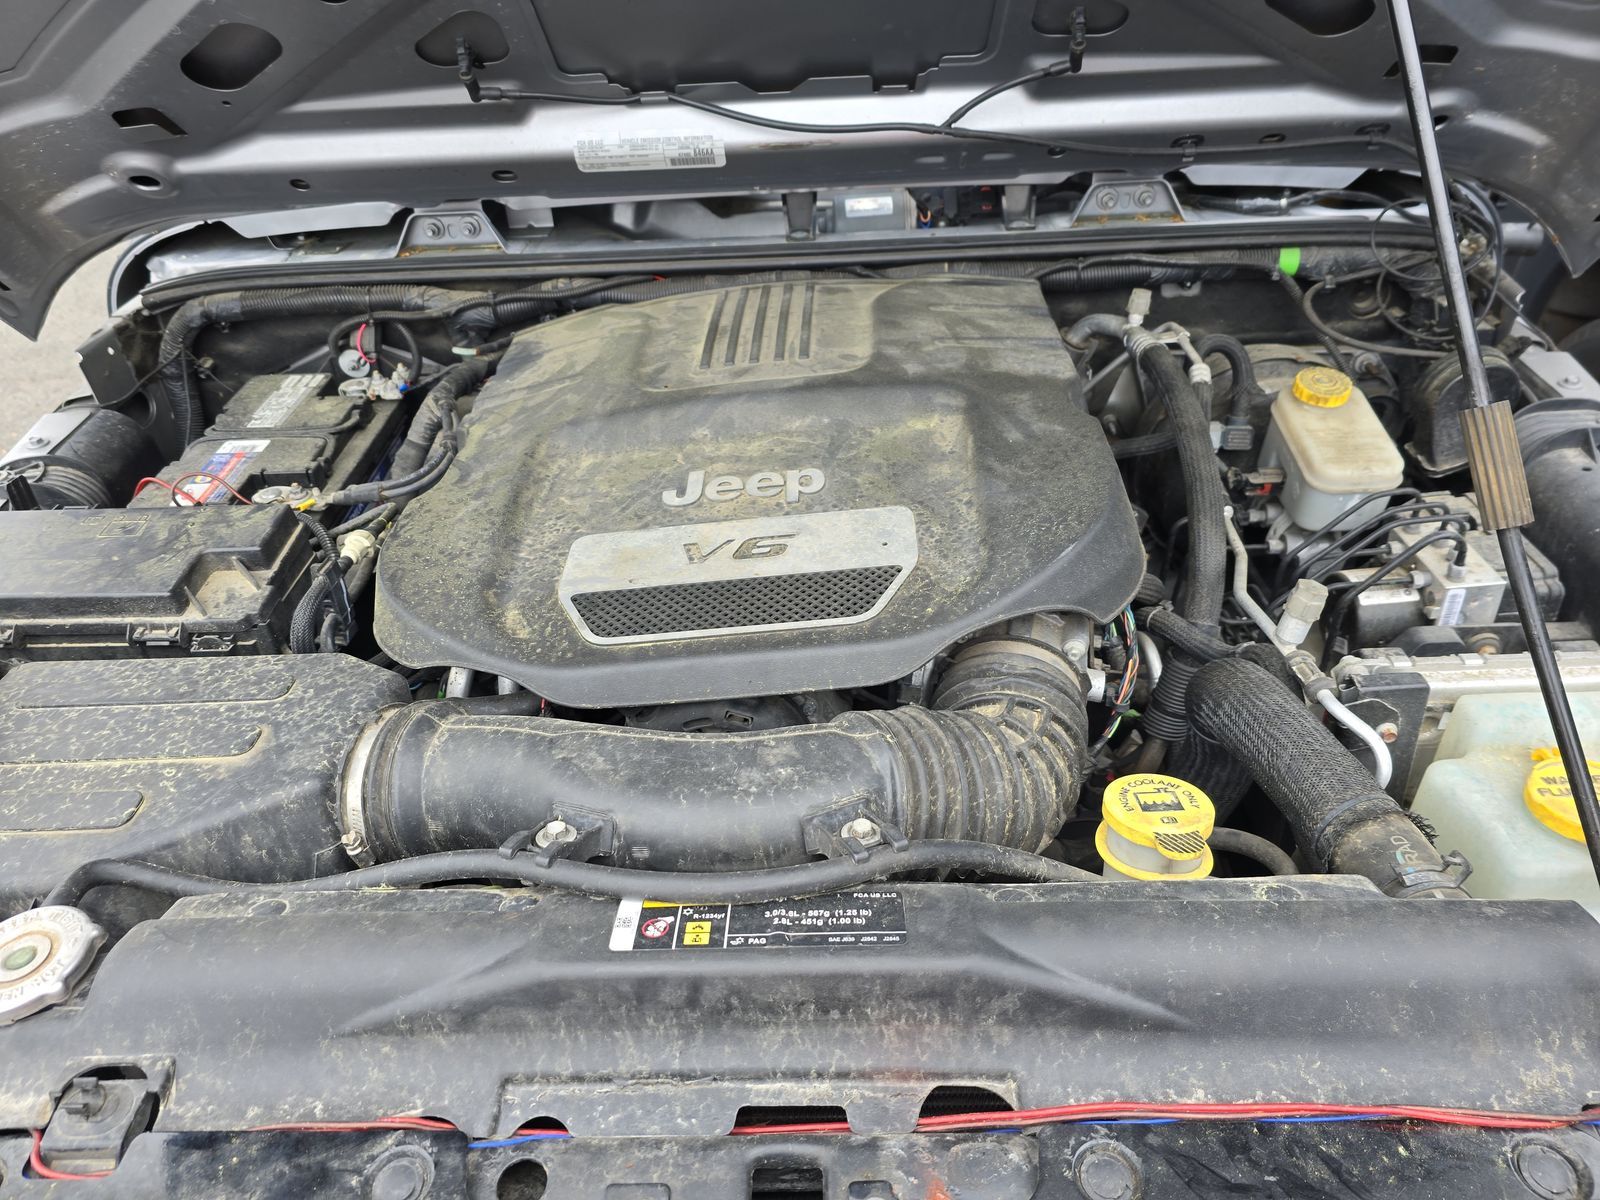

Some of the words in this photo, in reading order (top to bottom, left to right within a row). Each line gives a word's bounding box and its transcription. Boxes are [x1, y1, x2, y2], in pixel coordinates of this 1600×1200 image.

[661, 467, 826, 507] Jeep
[682, 533, 800, 565] V6
[1118, 786, 1135, 812] ENGINE
[1127, 778, 1182, 791] COOLANT
[1182, 790, 1201, 810] ONLY
[747, 937, 767, 945] PAG
